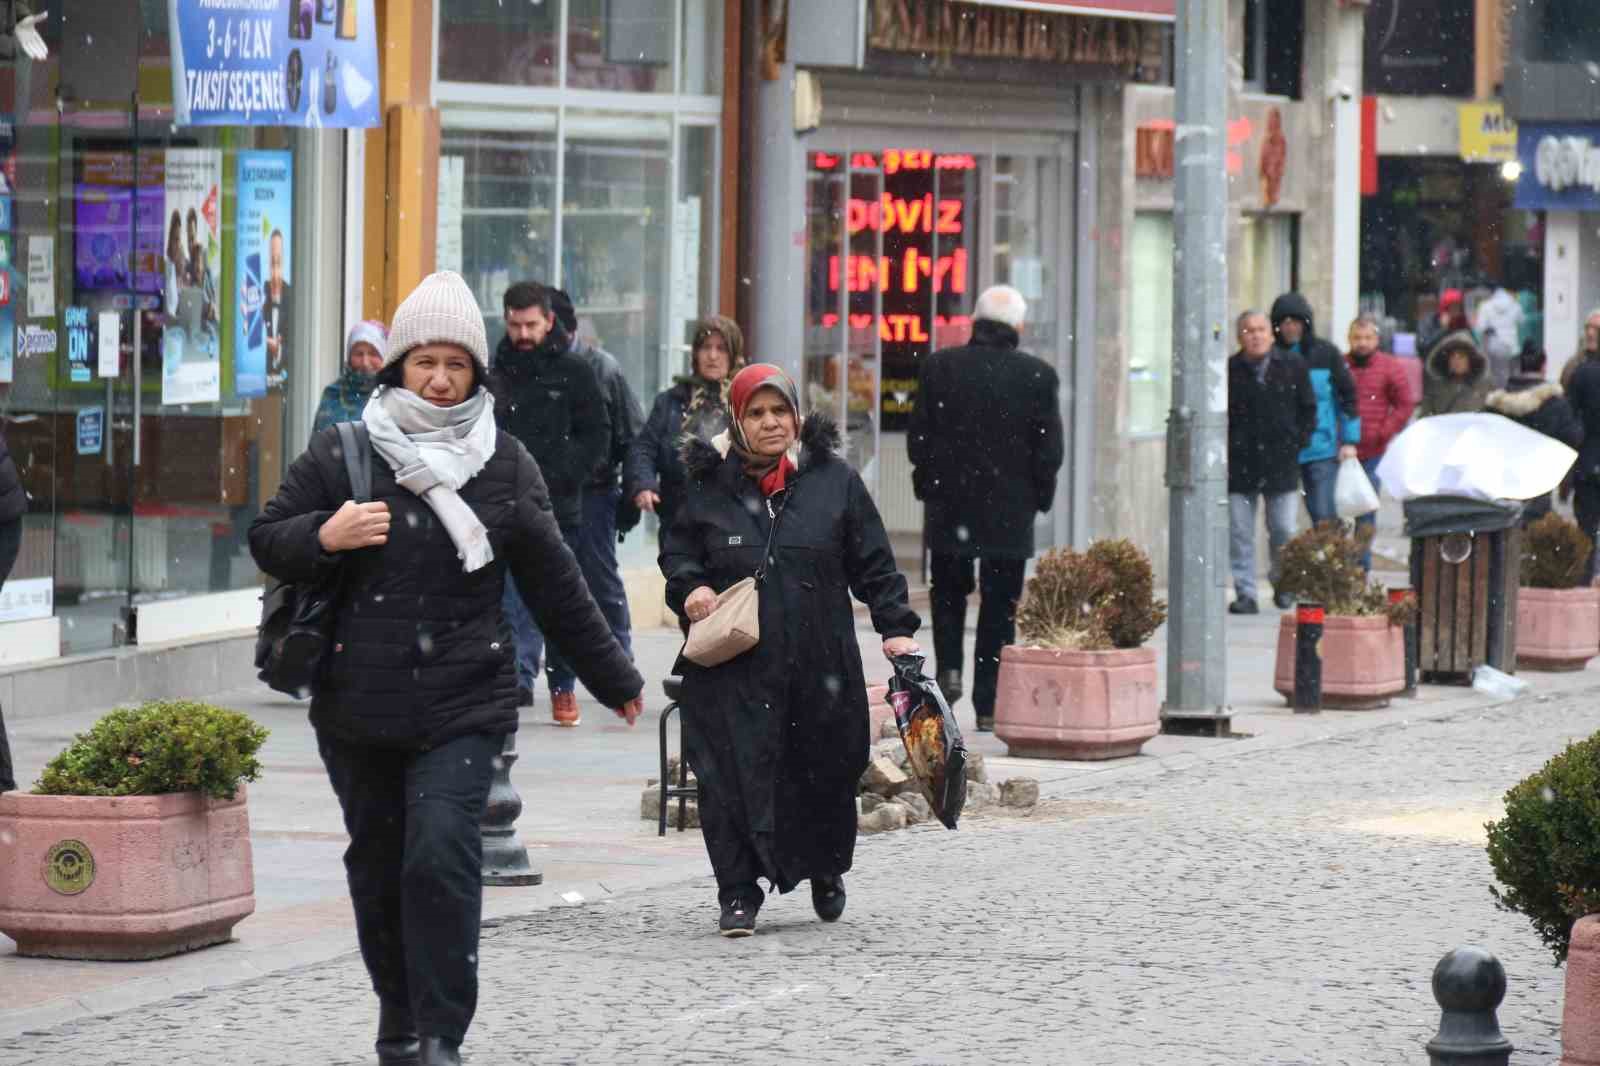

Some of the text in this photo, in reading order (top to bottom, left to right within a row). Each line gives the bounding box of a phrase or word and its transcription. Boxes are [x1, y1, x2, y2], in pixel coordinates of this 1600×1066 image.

[253, 19, 272, 59] AY
[188, 63, 231, 111] TAKSİT
[847, 192, 962, 233] DÖVİZ
[68, 327, 88, 361] ON
